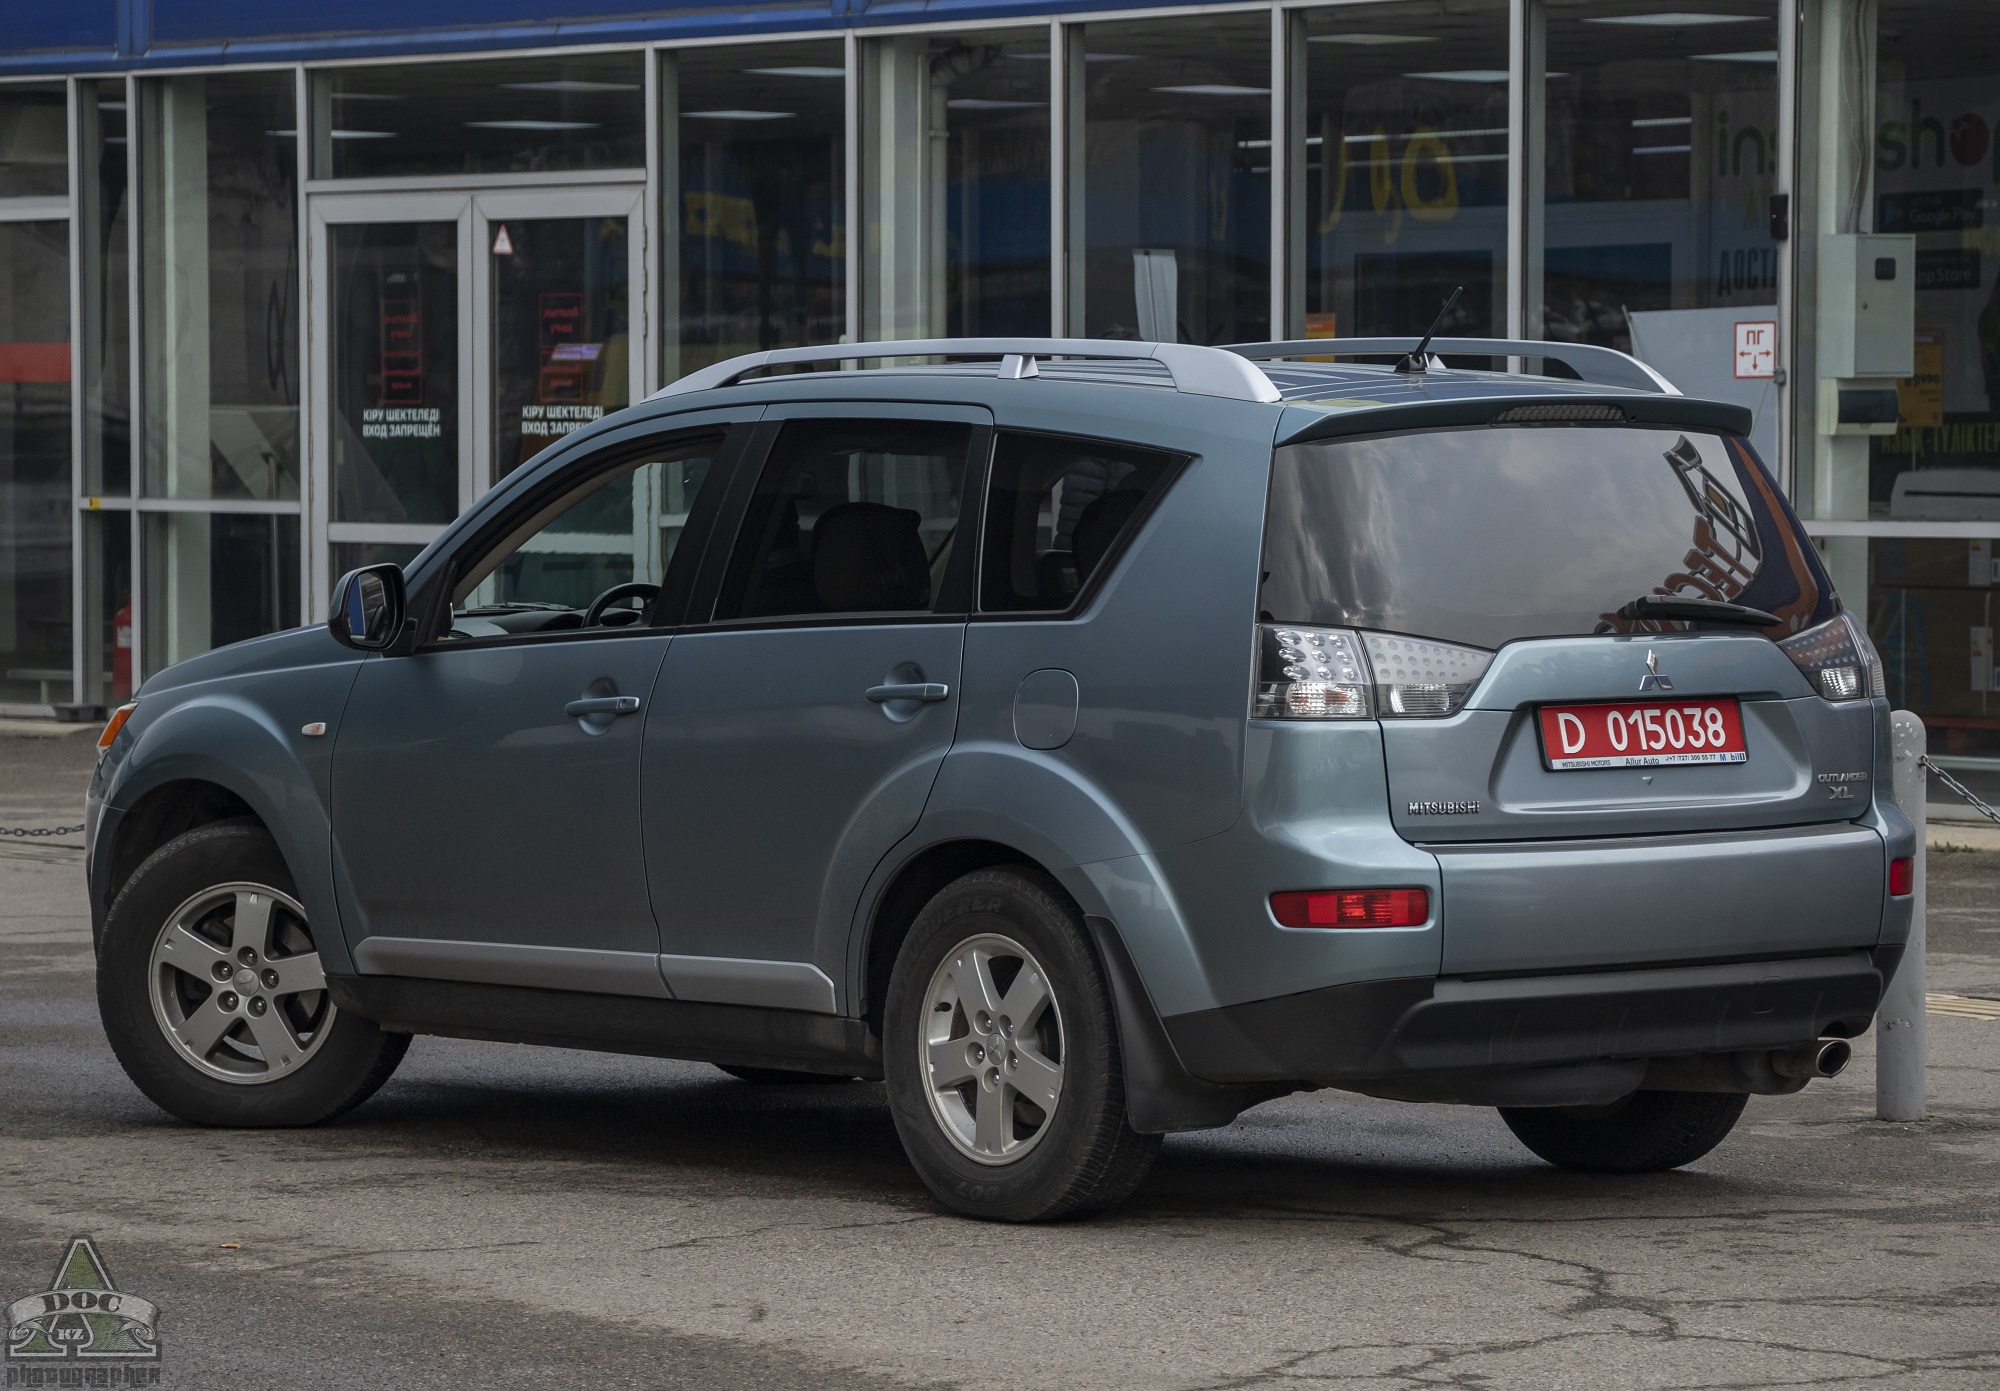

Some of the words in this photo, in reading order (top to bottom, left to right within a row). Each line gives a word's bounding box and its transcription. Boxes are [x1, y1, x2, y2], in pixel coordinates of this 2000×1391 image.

[1916, 270, 1935, 286] pp
[1746, 330, 1765, 346] ПГ
[363, 408, 384, 422] КІРУ
[385, 407, 440, 422] ШЕКТЕЛЕДІ
[522, 405, 545, 418] КІРУ
[546, 405, 604, 420] ШЕКТЕЛЕДІ
[362, 423, 387, 439] ВХОД
[521, 421, 548, 436] ВХОД
[549, 421, 588, 435] ЗАПРЕ
[1558, 712, 1586, 754] D
[1607, 707, 1726, 751] 015038
[1562, 760, 1590, 768] MITSUBISHI
[1591, 759, 1611, 767] MOTORS
[1625, 757, 1642, 766] Allur
[1643, 757, 1660, 765] Auto
[1818, 771, 1867, 783] OUTLANDER
[1829, 785, 1855, 800] XL
[1408, 800, 1480, 815] MITSUBISHI
